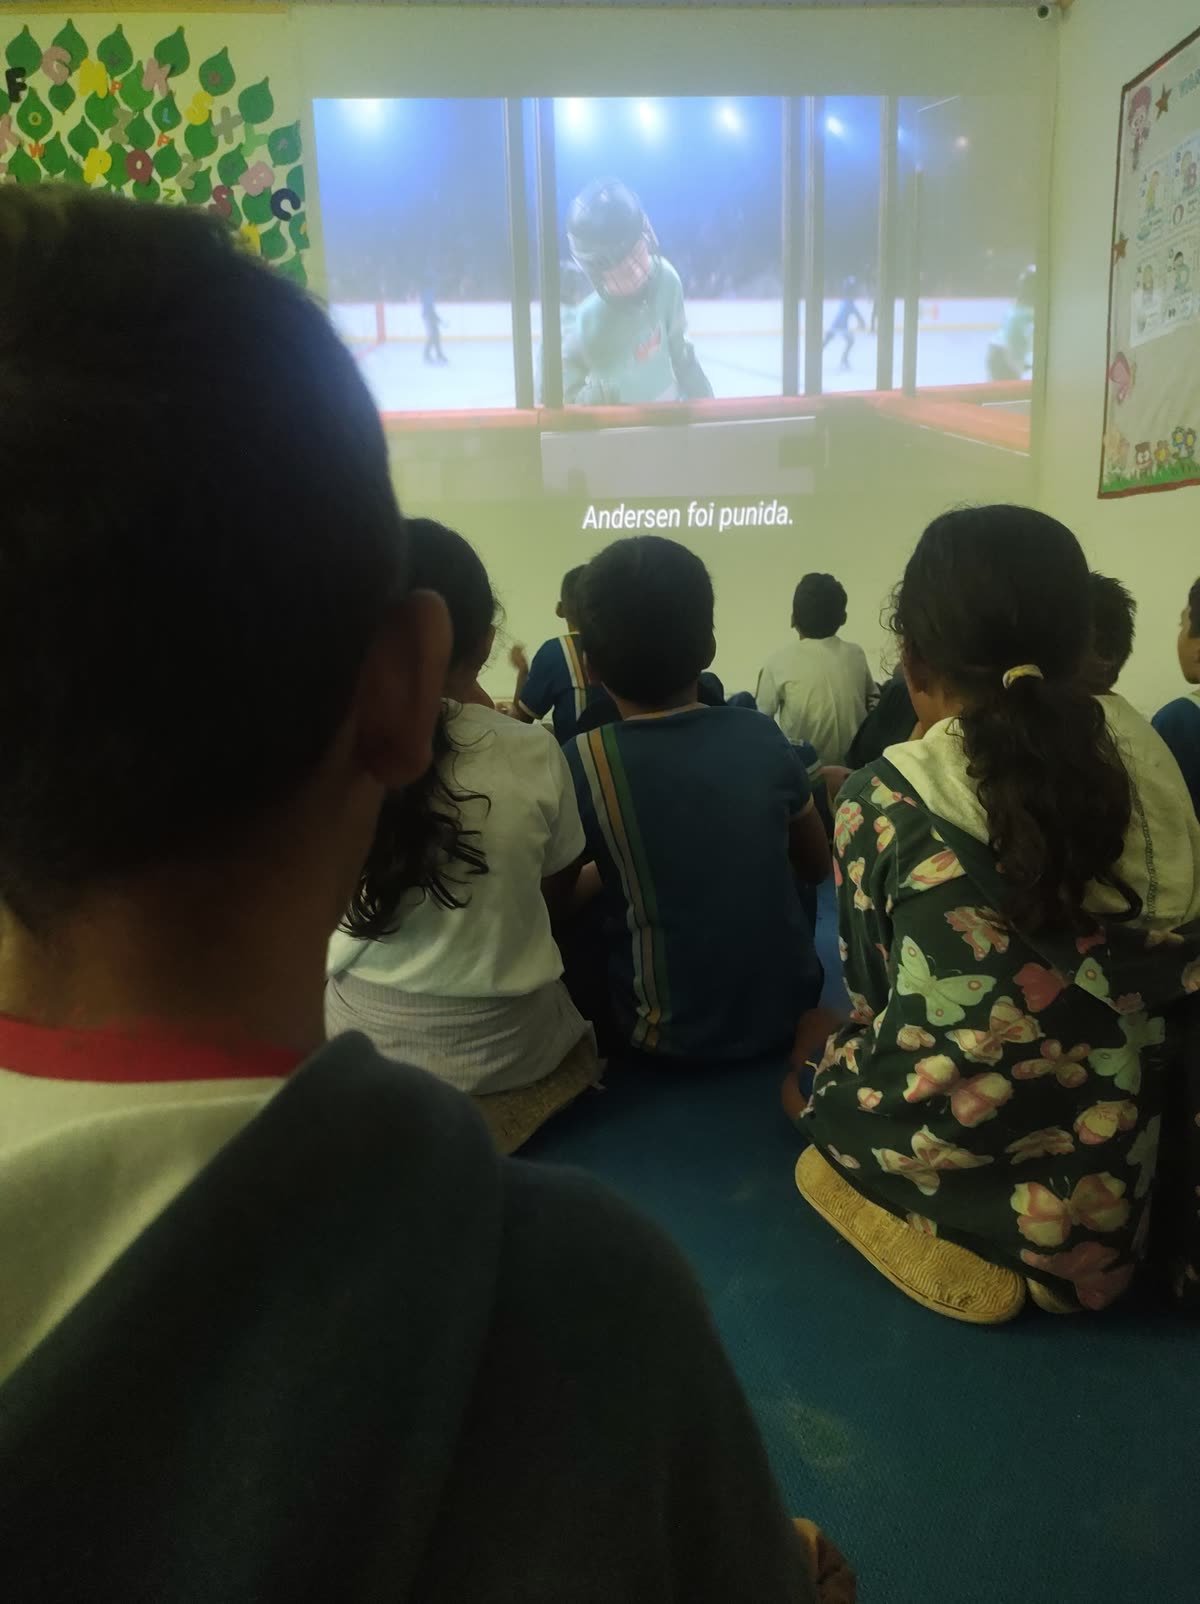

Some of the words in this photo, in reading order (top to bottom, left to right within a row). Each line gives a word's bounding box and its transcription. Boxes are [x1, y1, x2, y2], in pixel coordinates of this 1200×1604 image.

[5, 67, 27, 103] F
[270, 188, 301, 221] C
[582, 503, 681, 530] Andersen
[687, 500, 715, 528] foi
[718, 499, 793, 533] punida.
